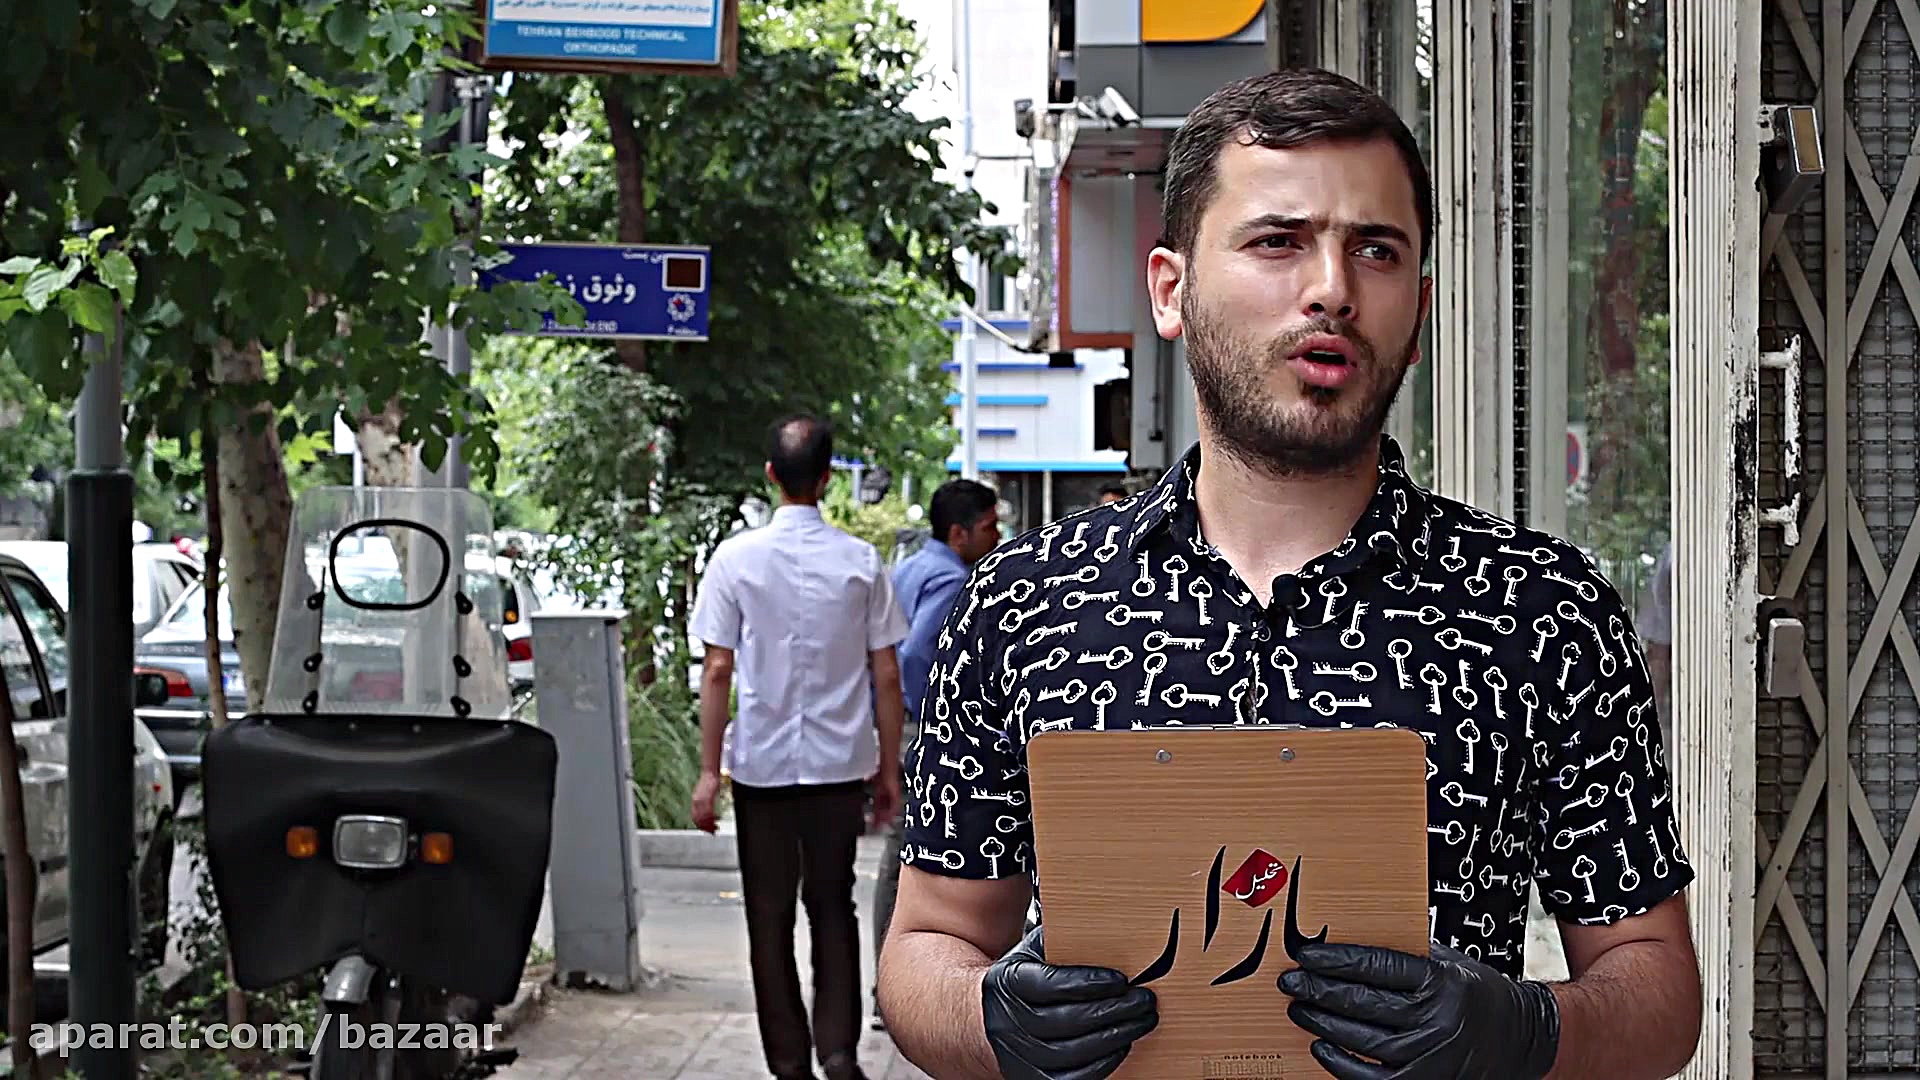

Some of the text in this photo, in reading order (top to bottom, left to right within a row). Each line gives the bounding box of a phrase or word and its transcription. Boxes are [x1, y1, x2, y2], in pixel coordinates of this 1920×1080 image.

[517, 24, 561, 37] TEHRAN
[623, 28, 687, 41] TECHNICAL
[582, 272, 637, 304] وثوق
[1235, 862, 1283, 900] تحلیل
[1224, 1053, 1282, 1061] notebook
